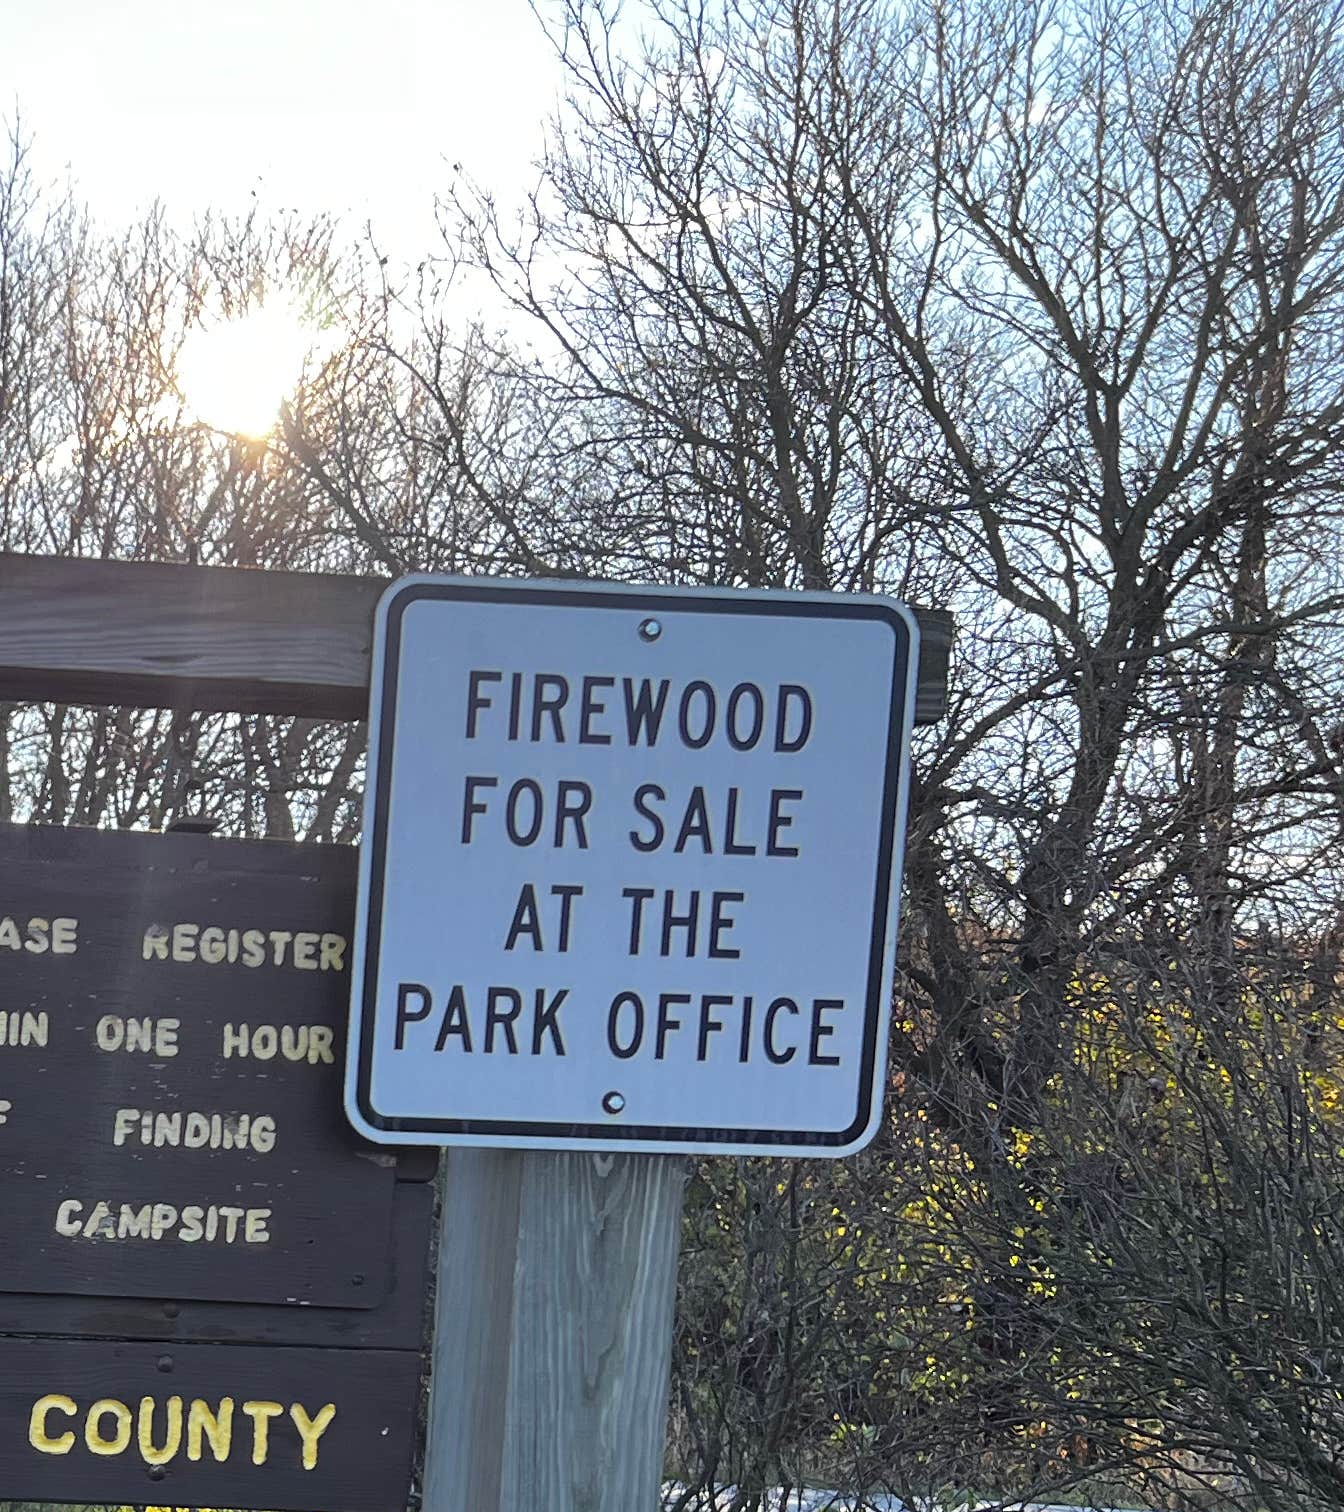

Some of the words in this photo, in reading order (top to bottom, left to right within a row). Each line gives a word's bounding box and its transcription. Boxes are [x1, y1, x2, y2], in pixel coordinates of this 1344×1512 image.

[466, 671, 812, 752] FIREWOOD
[462, 776, 591, 848] FOR
[630, 784, 802, 857] SALE
[142, 923, 347, 971] REGISTER
[505, 884, 583, 952] AT
[623, 888, 744, 958] THE
[95, 1015, 181, 1057] ONE
[222, 1022, 335, 1065] HOUR
[394, 984, 569, 1056] PARK
[608, 992, 843, 1065] OFFICE
[113, 1108, 277, 1153] FINDING
[55, 1199, 273, 1243] CAMPSITE
[29, 1395, 336, 1470] COUNTY
